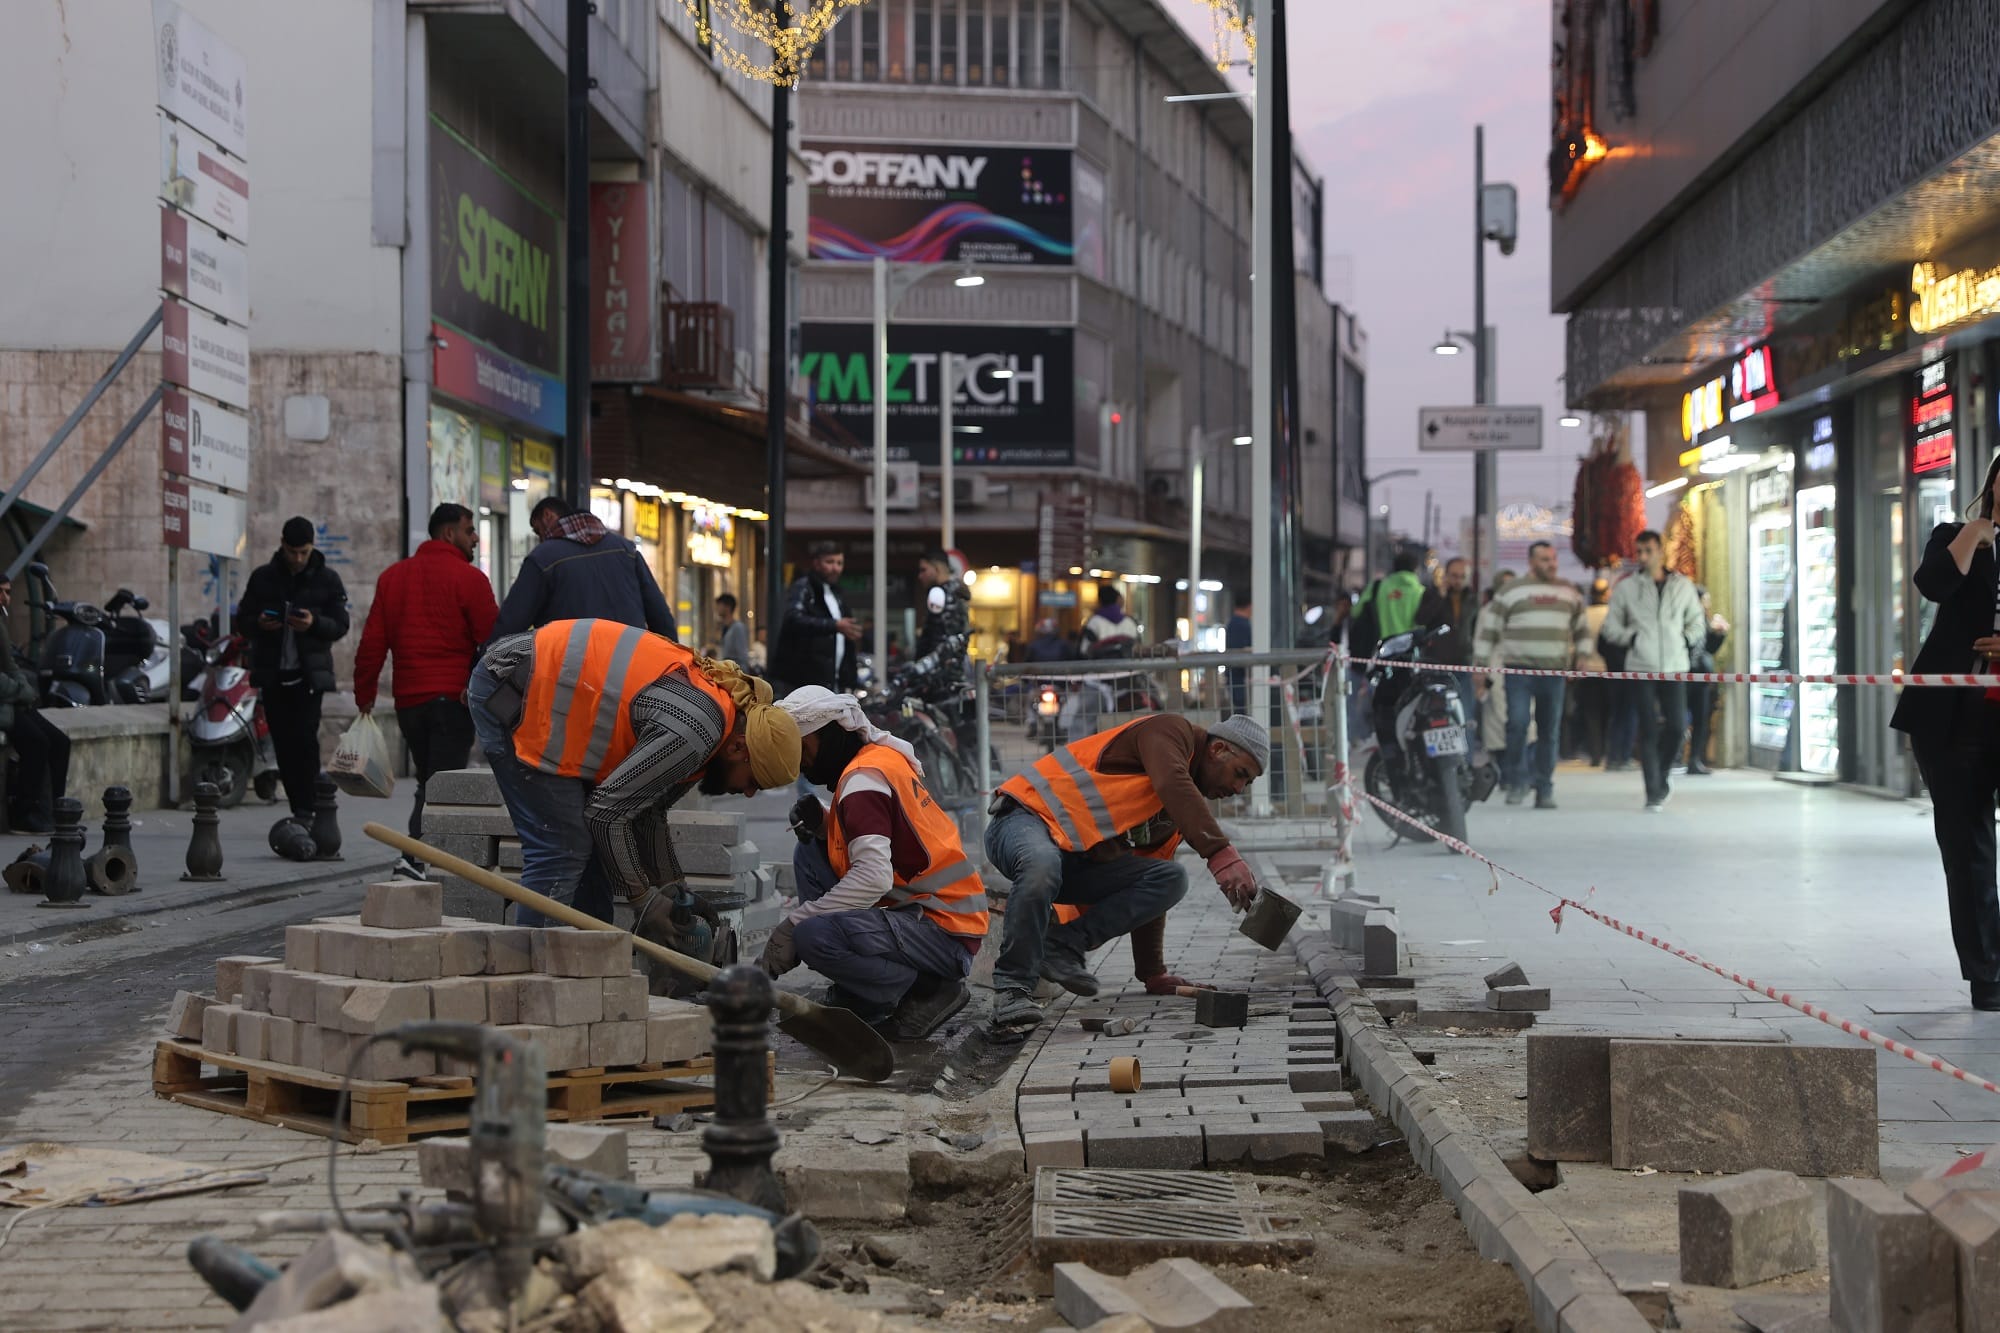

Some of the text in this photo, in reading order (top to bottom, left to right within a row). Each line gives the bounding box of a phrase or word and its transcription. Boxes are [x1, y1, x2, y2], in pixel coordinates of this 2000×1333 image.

[801, 149, 989, 189] SOFFANY
[457, 192, 551, 332] SOFFANY
[604, 216, 628, 357] YILMAZ
